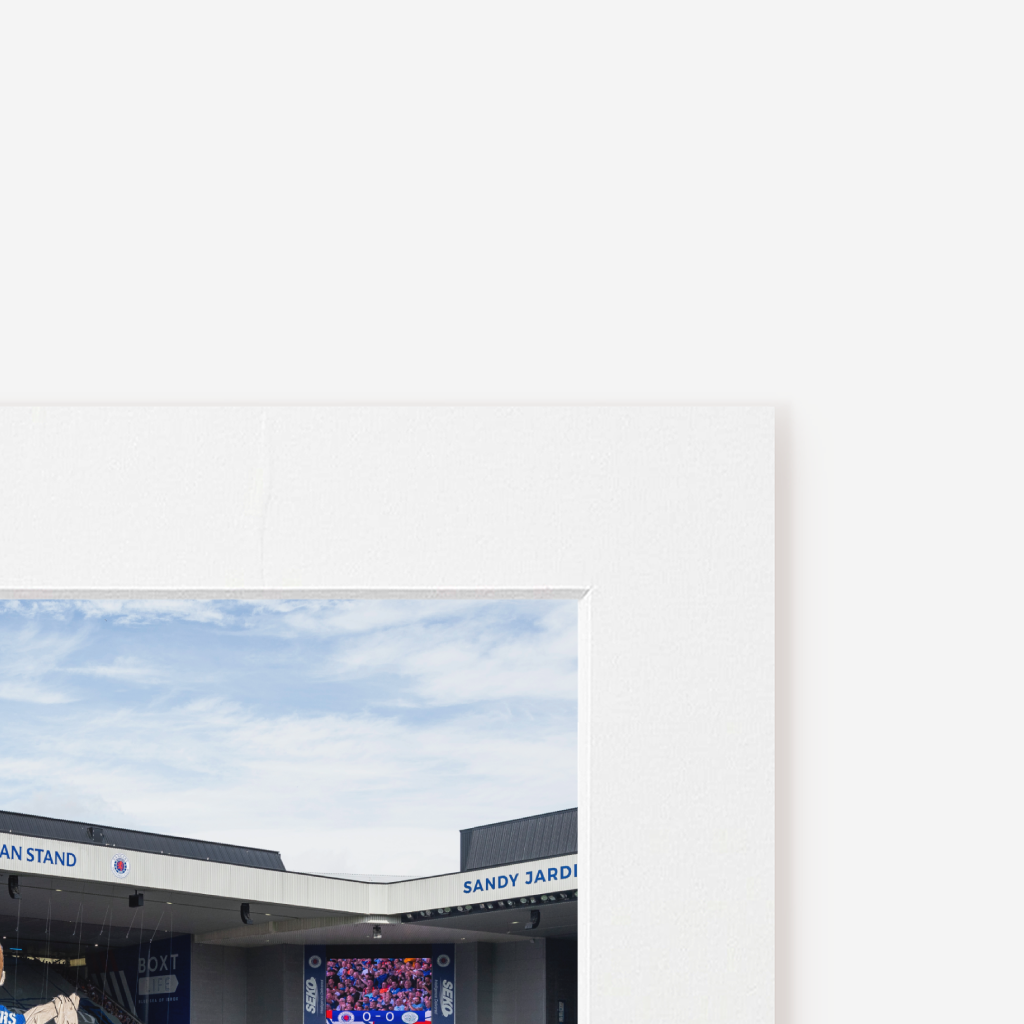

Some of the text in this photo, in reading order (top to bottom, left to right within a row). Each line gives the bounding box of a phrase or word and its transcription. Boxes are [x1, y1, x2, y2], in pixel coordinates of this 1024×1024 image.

[26, 848, 77, 867] STAND
[463, 864, 578, 894] SANDY JARDI
[138, 953, 179, 974] BOXT
[146, 977, 171, 993] IFE
[305, 976, 317, 1015] SEKO
[442, 979, 454, 1018] SEKO
[385, 1011, 395, 1022] 0
